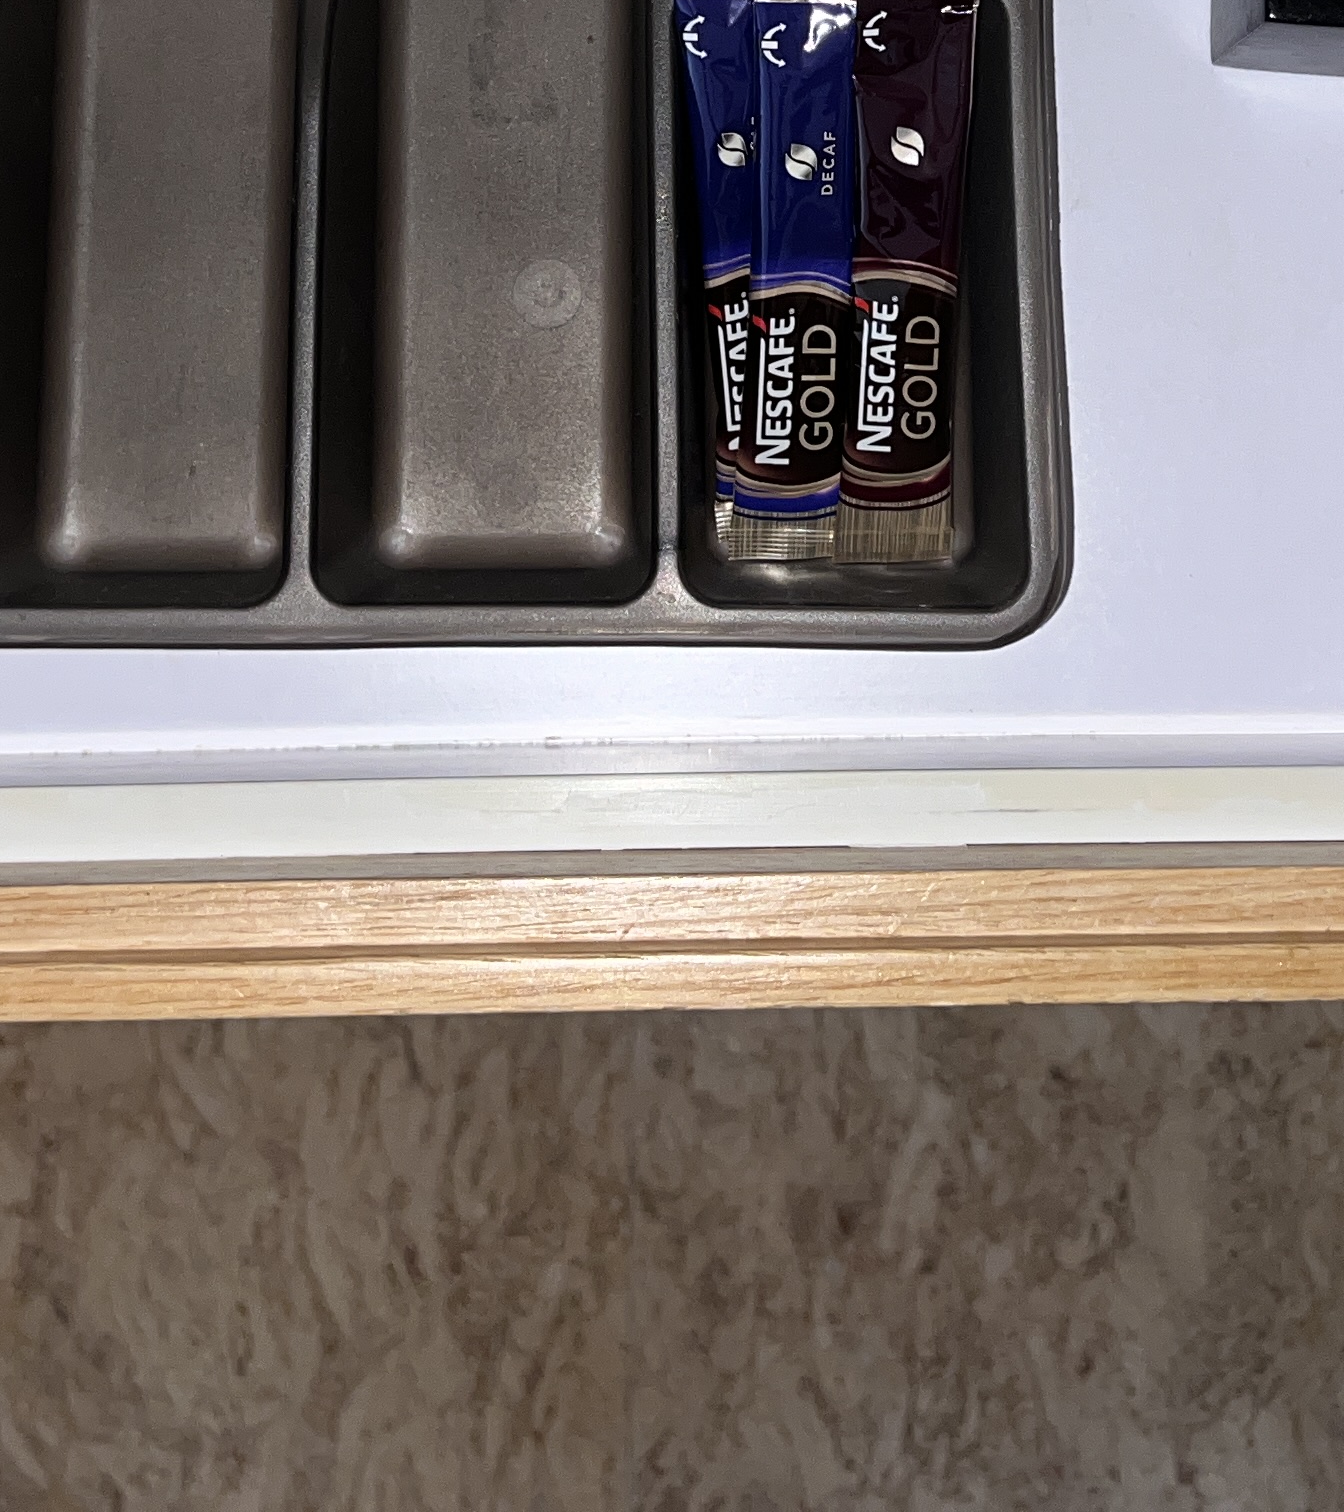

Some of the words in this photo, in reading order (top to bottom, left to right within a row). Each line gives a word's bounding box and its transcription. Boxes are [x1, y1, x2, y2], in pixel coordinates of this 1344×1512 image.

[820, 131, 836, 196] DECAF
[798, 324, 837, 451] GOLD
[900, 315, 940, 440] GOLD
